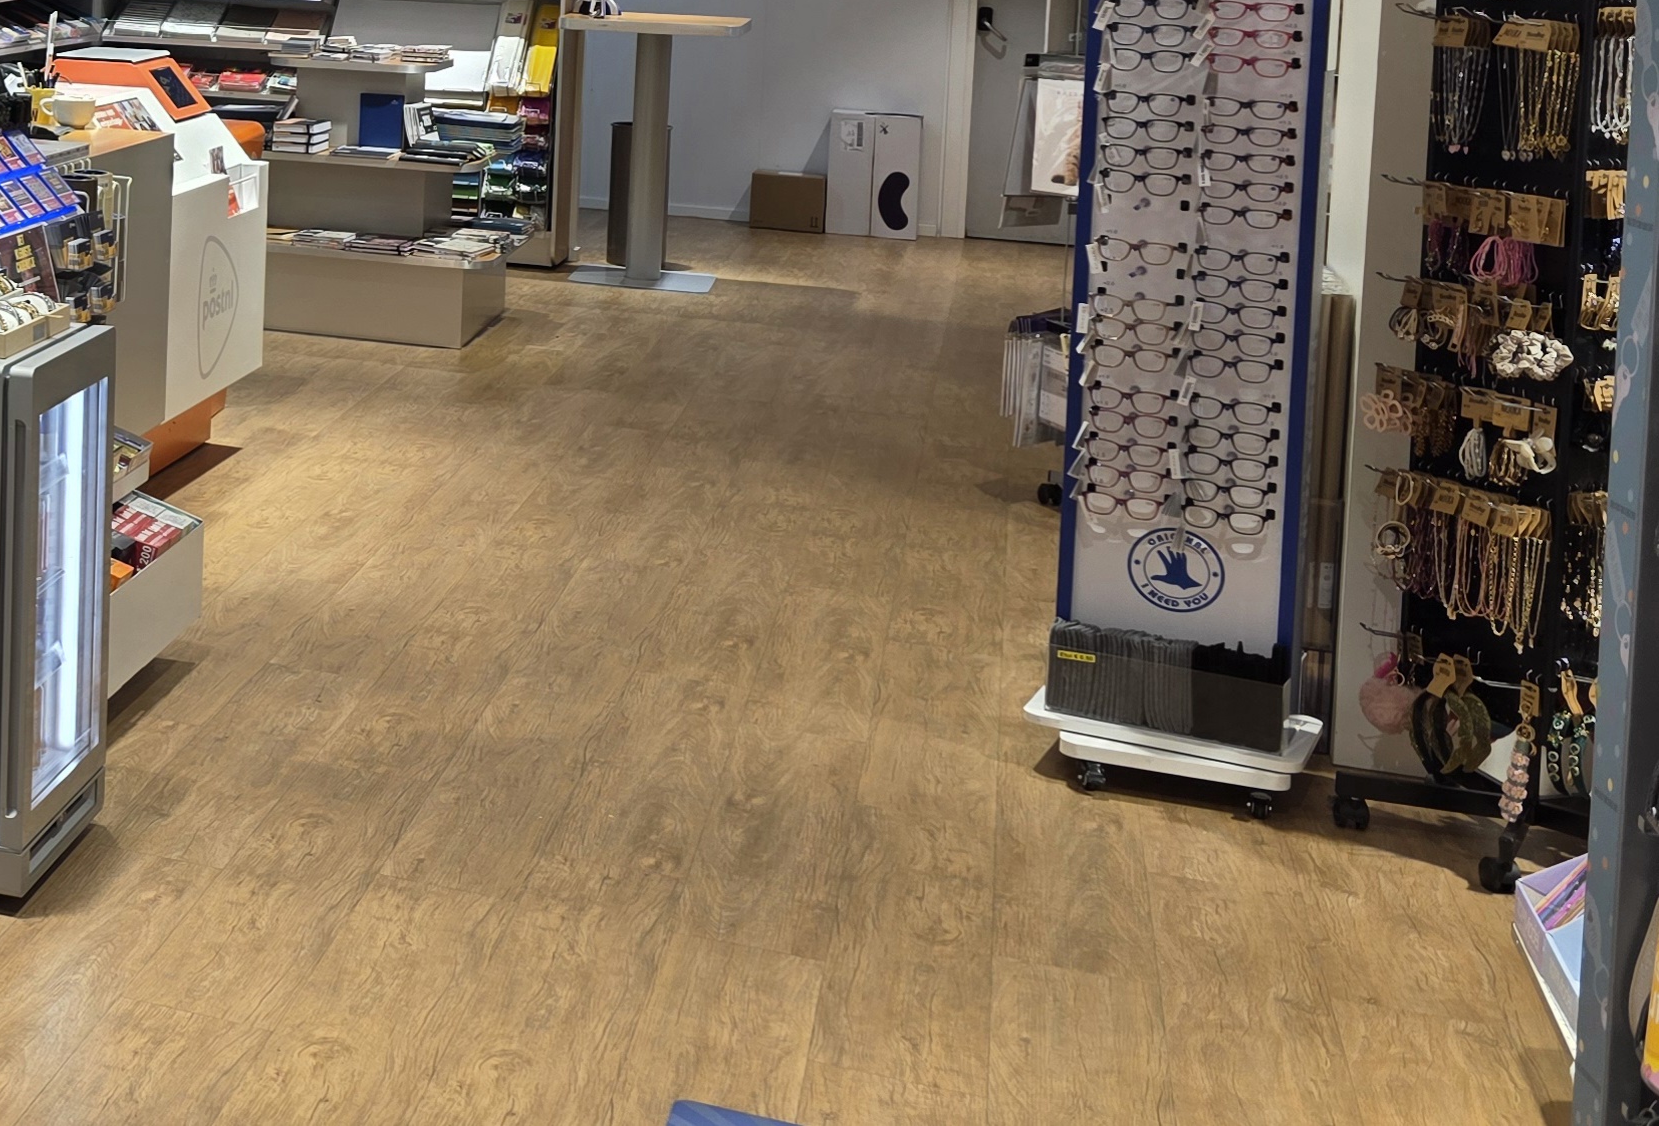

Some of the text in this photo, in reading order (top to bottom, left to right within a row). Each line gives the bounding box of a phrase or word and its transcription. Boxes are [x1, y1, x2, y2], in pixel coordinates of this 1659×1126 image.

[202, 279, 234, 331] postnl
[138, 544, 153, 566] 200
[1147, 531, 1210, 556] ORIGNAL
[1148, 588, 1179, 608] NEED
[1184, 593, 1209, 608] YOU
